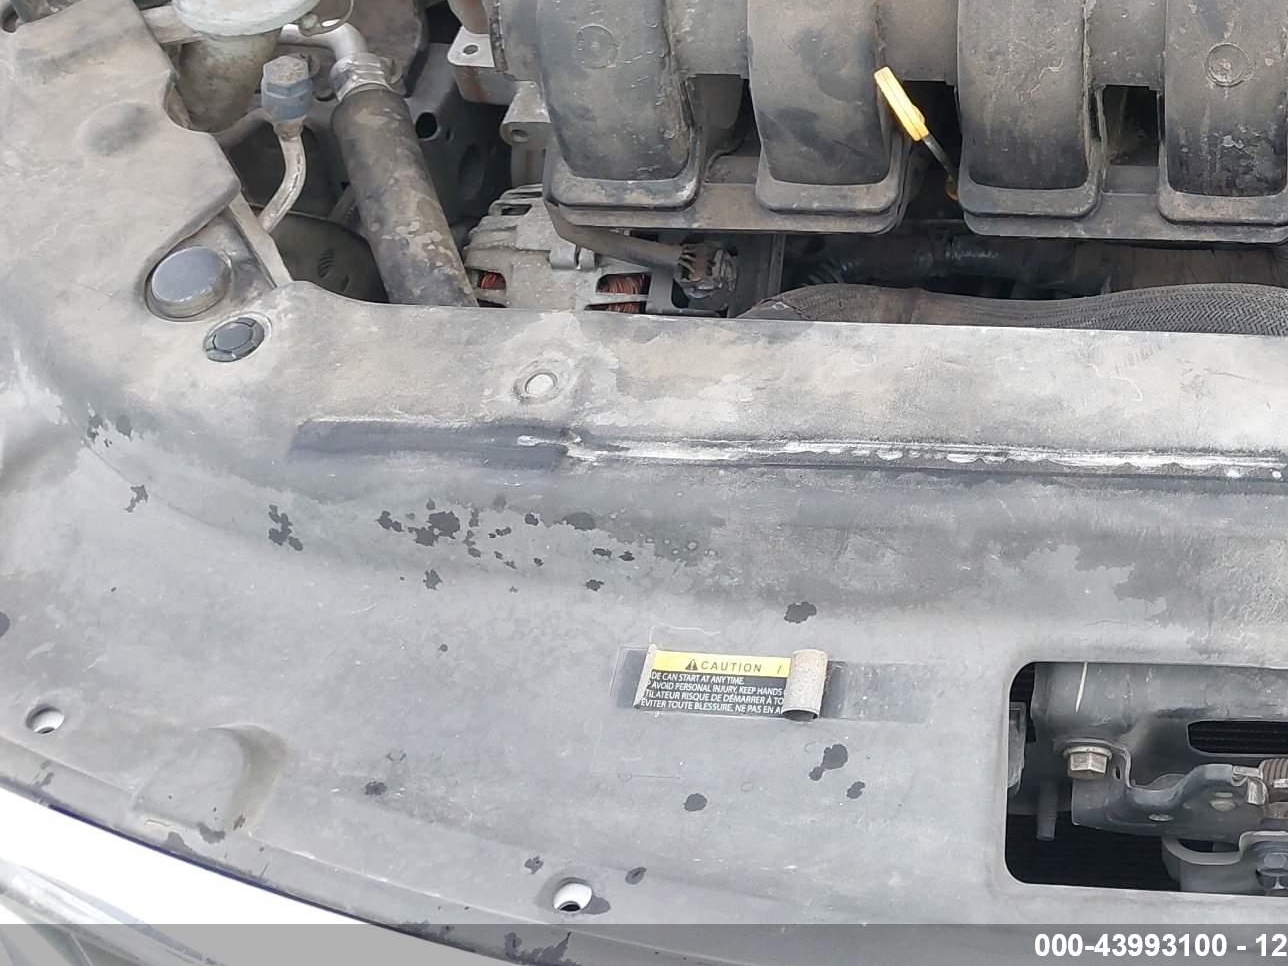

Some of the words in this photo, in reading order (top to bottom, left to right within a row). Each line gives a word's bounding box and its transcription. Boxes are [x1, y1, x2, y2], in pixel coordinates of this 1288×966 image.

[701, 660, 762, 672] CAUTION
[662, 673, 678, 681] CAN
[678, 674, 700, 682] START
[711, 675, 726, 684] ANY
[652, 681, 674, 690] AVOID
[675, 682, 711, 692] PERSONAL
[739, 686, 756, 694] KEEP
[757, 687, 782, 696] HANDS
[681, 692, 710, 702] RISQUE
[723, 694, 765, 704] DÉMARRER
[766, 695, 772, 704] À
[667, 700, 694, 709] TOUTE
[735, 704, 746, 712] NE
[747, 704, 762, 713] PAS
[763, 706, 774, 714] EN
